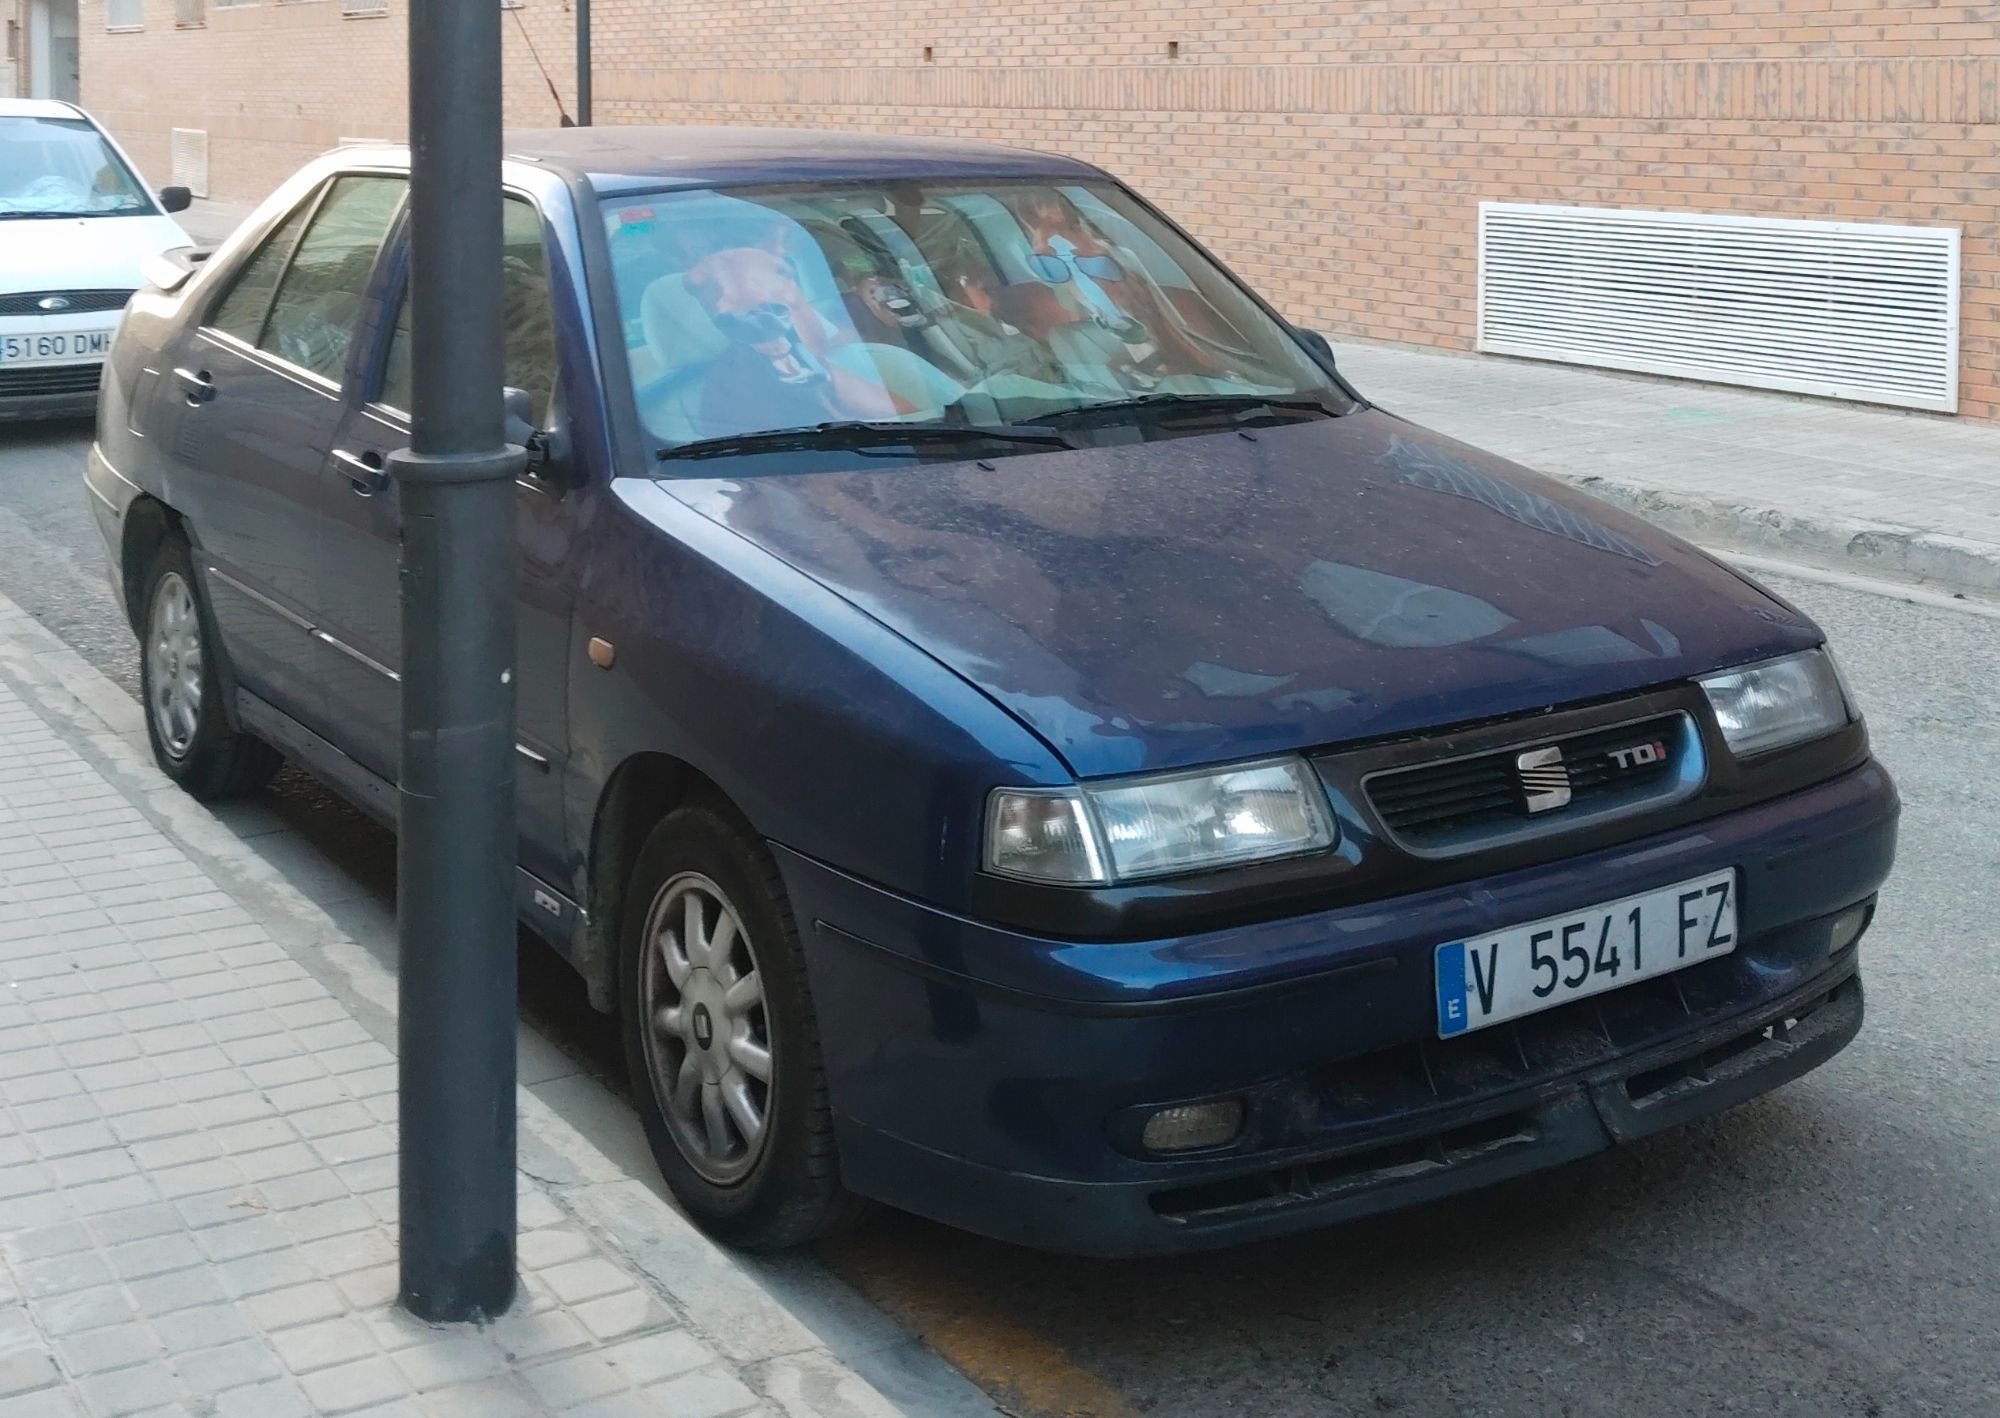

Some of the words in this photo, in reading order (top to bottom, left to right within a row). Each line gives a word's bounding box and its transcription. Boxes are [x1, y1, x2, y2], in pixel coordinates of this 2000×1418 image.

[6, 336, 66, 358] 5160
[1470, 943, 1499, 1016] V
[1530, 906, 1642, 998] 5541
[1678, 881, 1733, 959] FZ
[1447, 998, 1461, 1020] E
